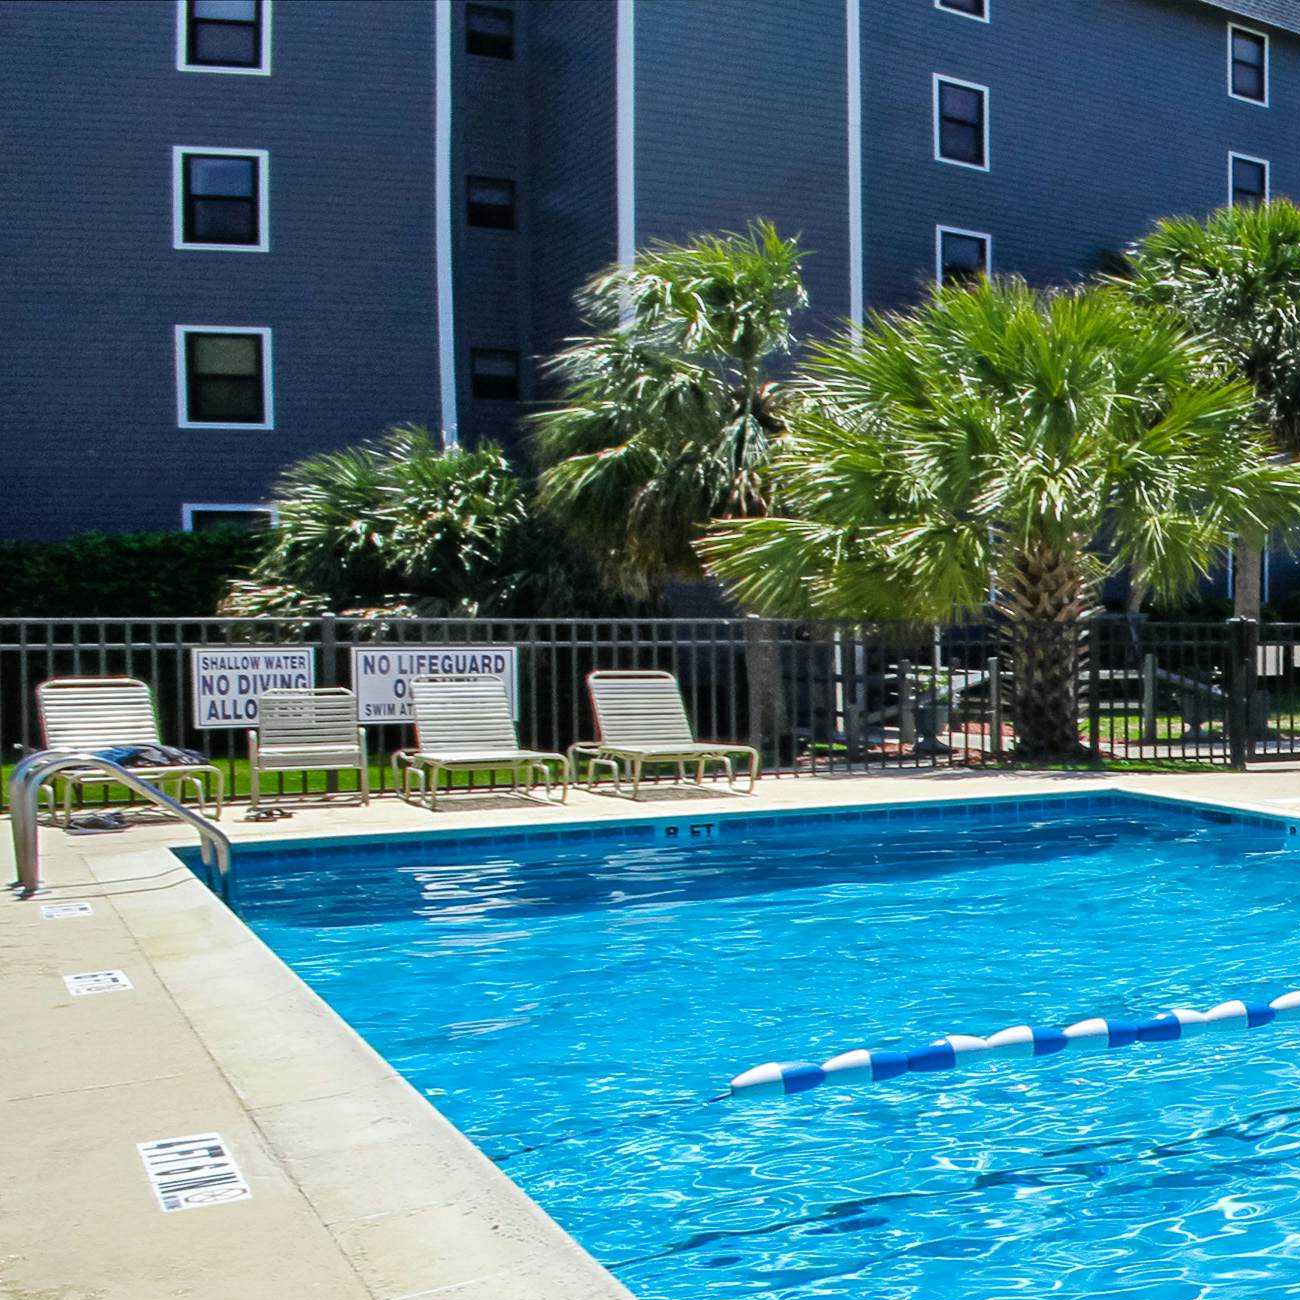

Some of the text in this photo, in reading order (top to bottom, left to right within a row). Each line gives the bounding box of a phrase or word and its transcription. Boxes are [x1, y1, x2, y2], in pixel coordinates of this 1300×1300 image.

[201, 655, 306, 671] SHALLOW WATER
[363, 655, 506, 675] NO LIFEGUARD
[201, 673, 307, 696] NO DIVING
[364, 703, 413, 717] SWIM AT
[142, 1137, 218, 1151] 4
[147, 1145, 225, 1165] FT
[158, 1172, 240, 1194] IN
